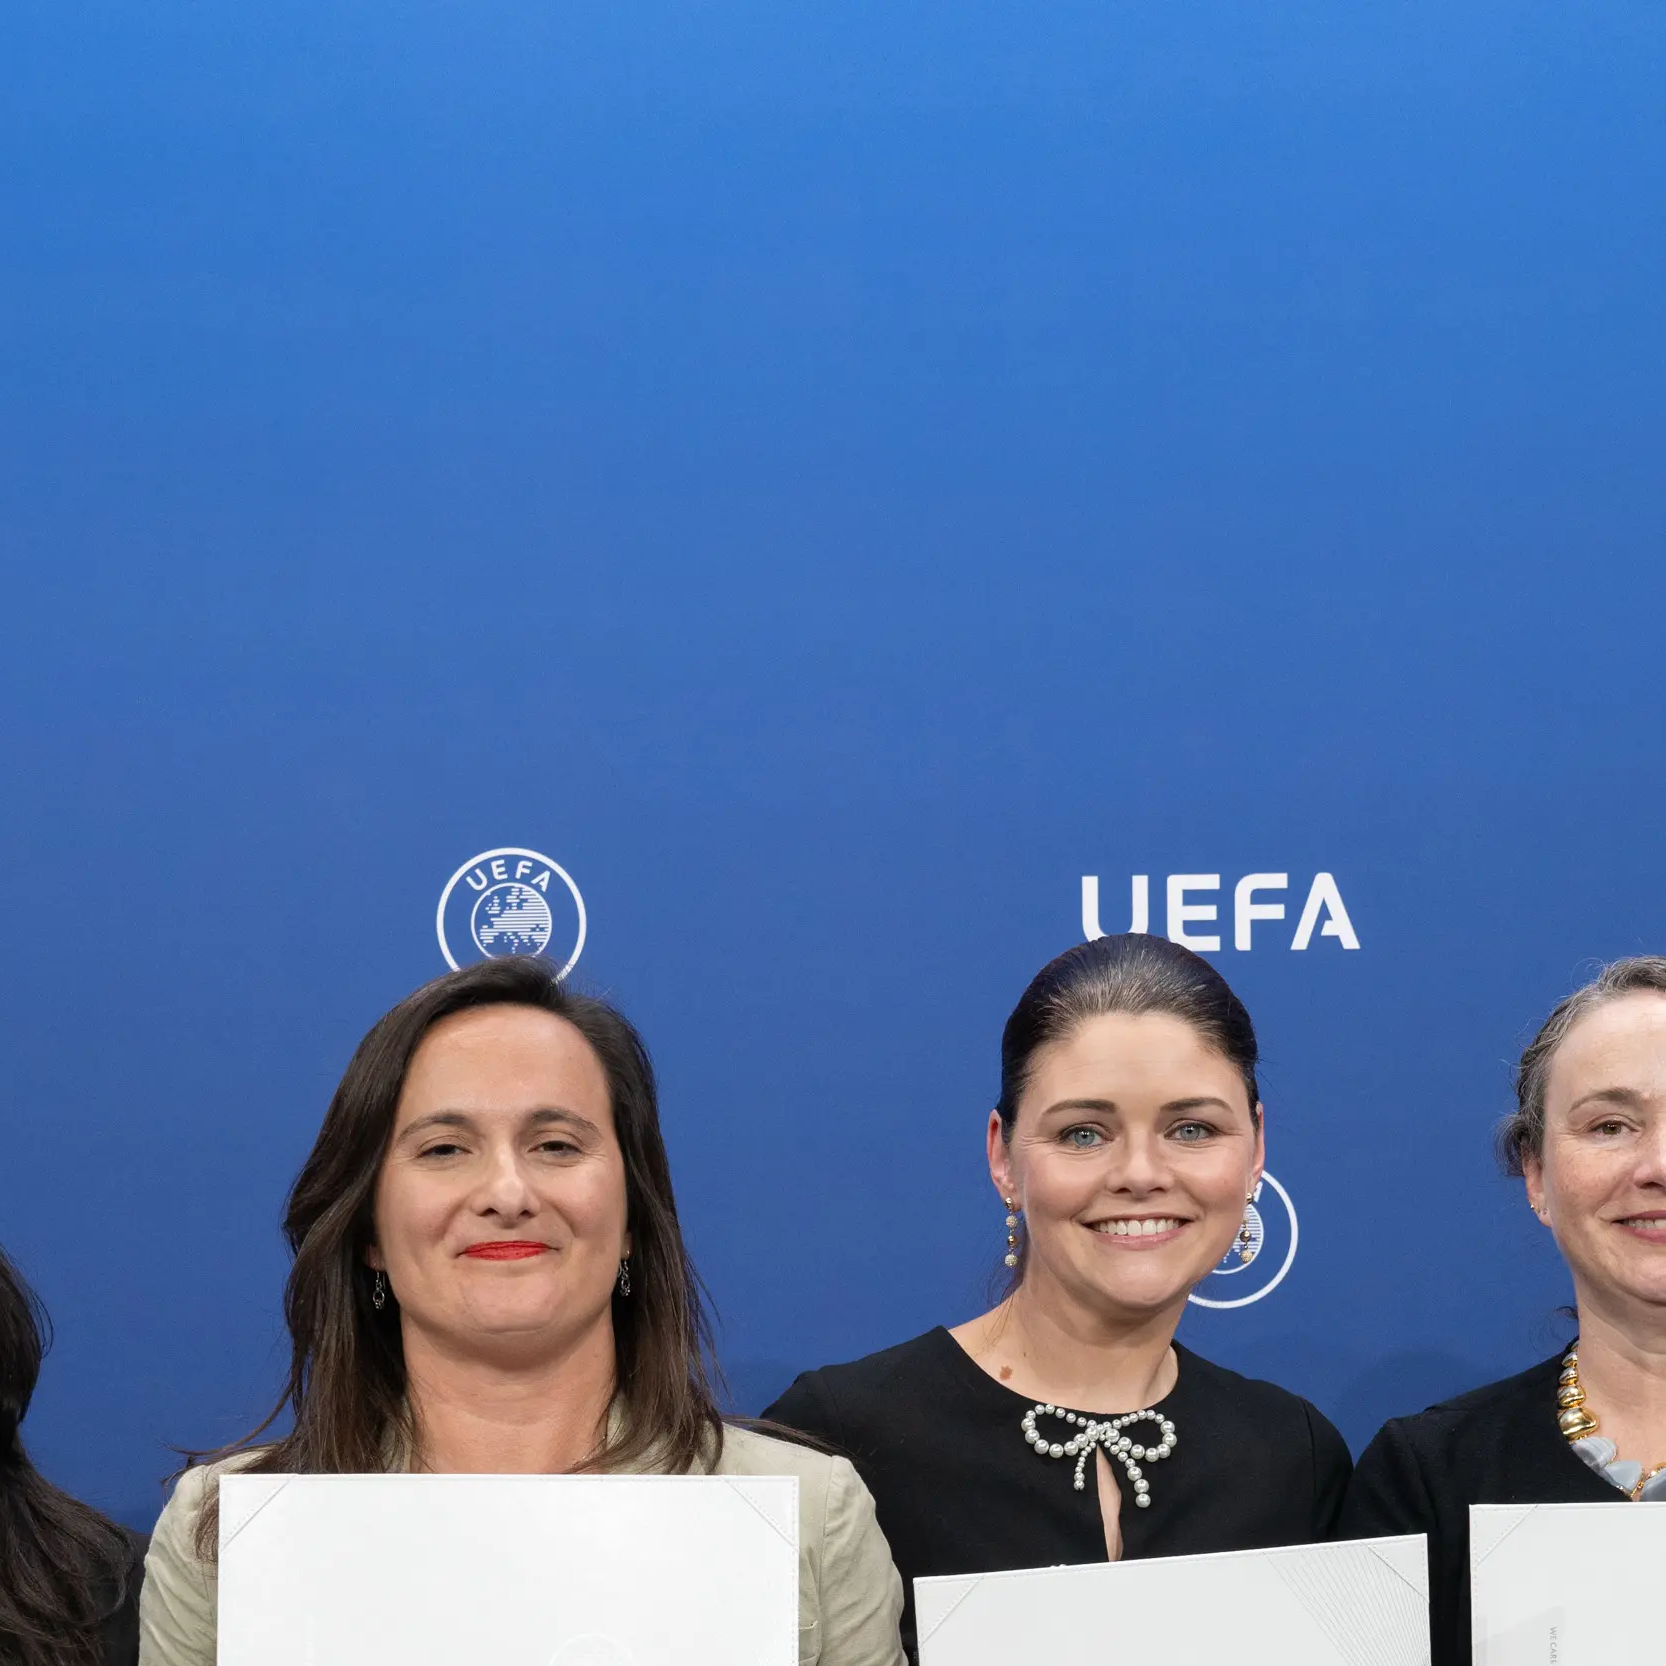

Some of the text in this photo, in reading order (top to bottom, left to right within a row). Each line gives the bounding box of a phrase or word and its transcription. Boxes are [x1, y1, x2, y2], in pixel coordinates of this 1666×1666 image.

[465, 859, 551, 892] UEFA
[1081, 872, 1361, 951] UEFA
[1549, 1626, 1557, 1641] WE
